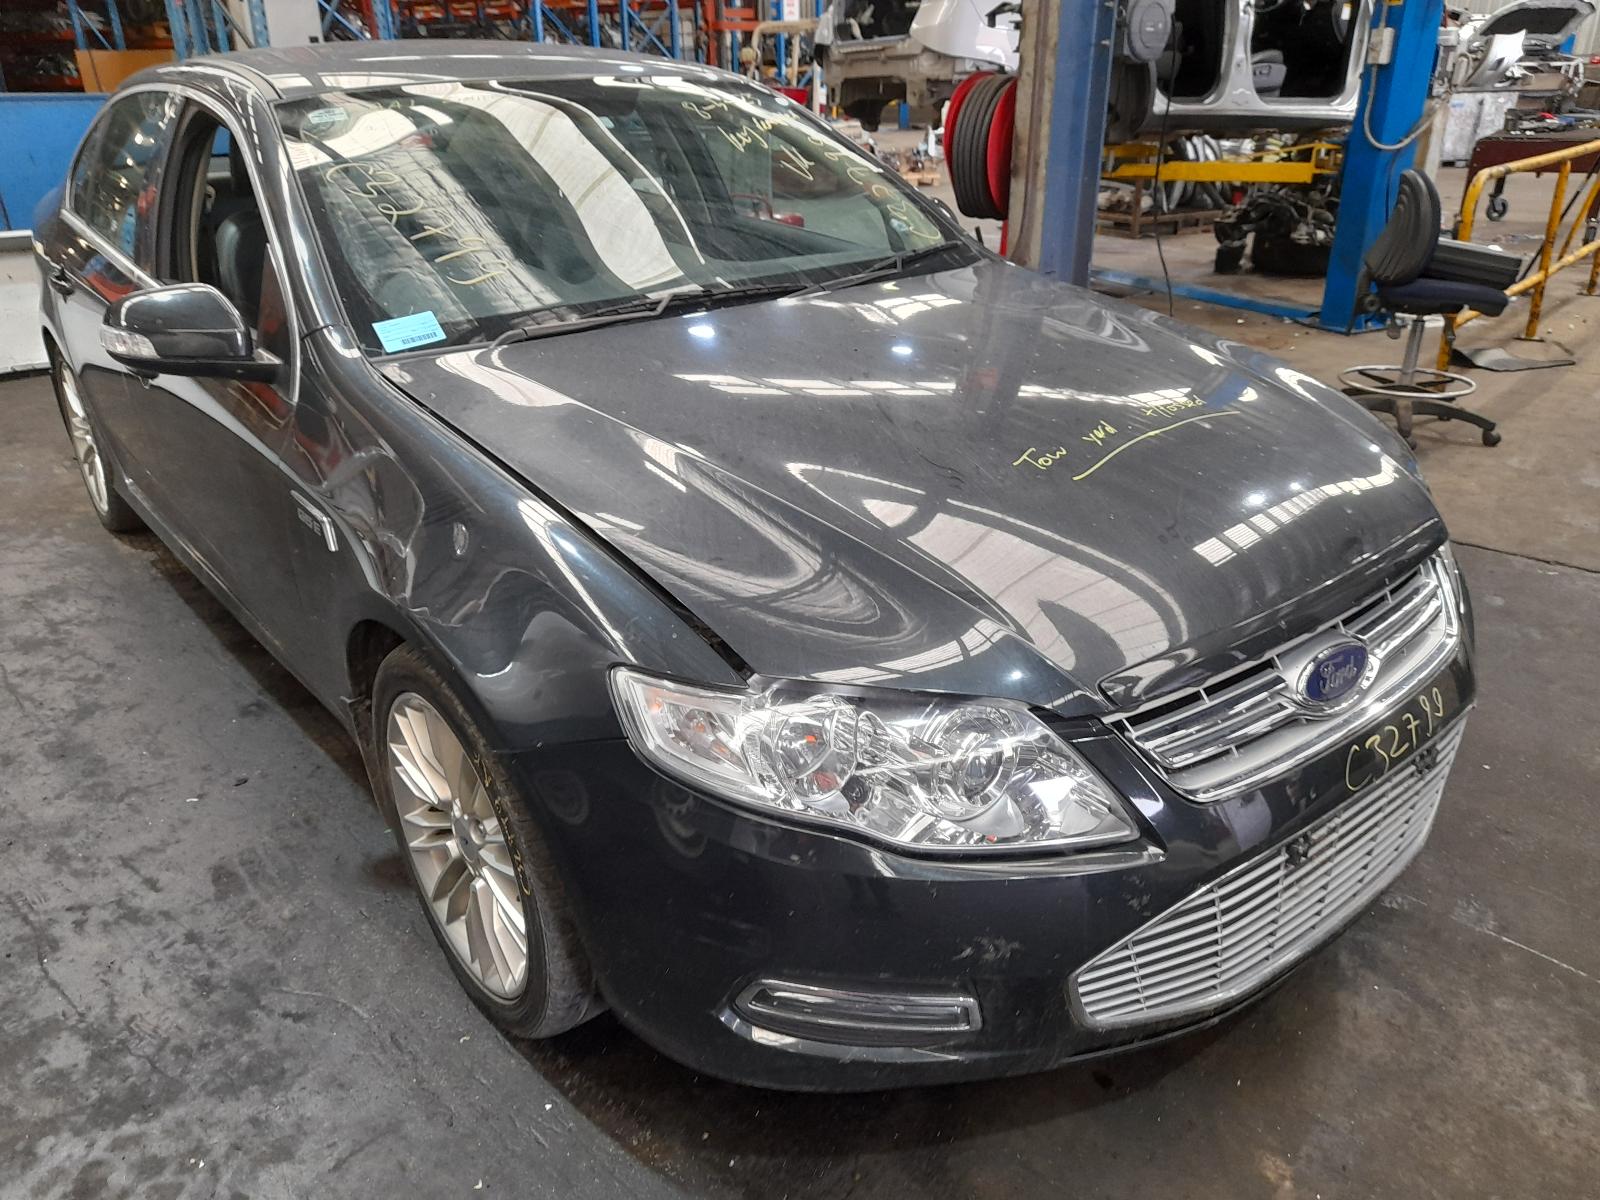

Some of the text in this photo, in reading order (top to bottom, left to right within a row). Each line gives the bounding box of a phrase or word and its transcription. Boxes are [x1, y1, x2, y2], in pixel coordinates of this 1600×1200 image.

[325, 162, 510, 285] C32799
[1012, 447, 1068, 470] Tow
[1319, 654, 1358, 695] Ford
[1345, 686, 1444, 791] C32799
